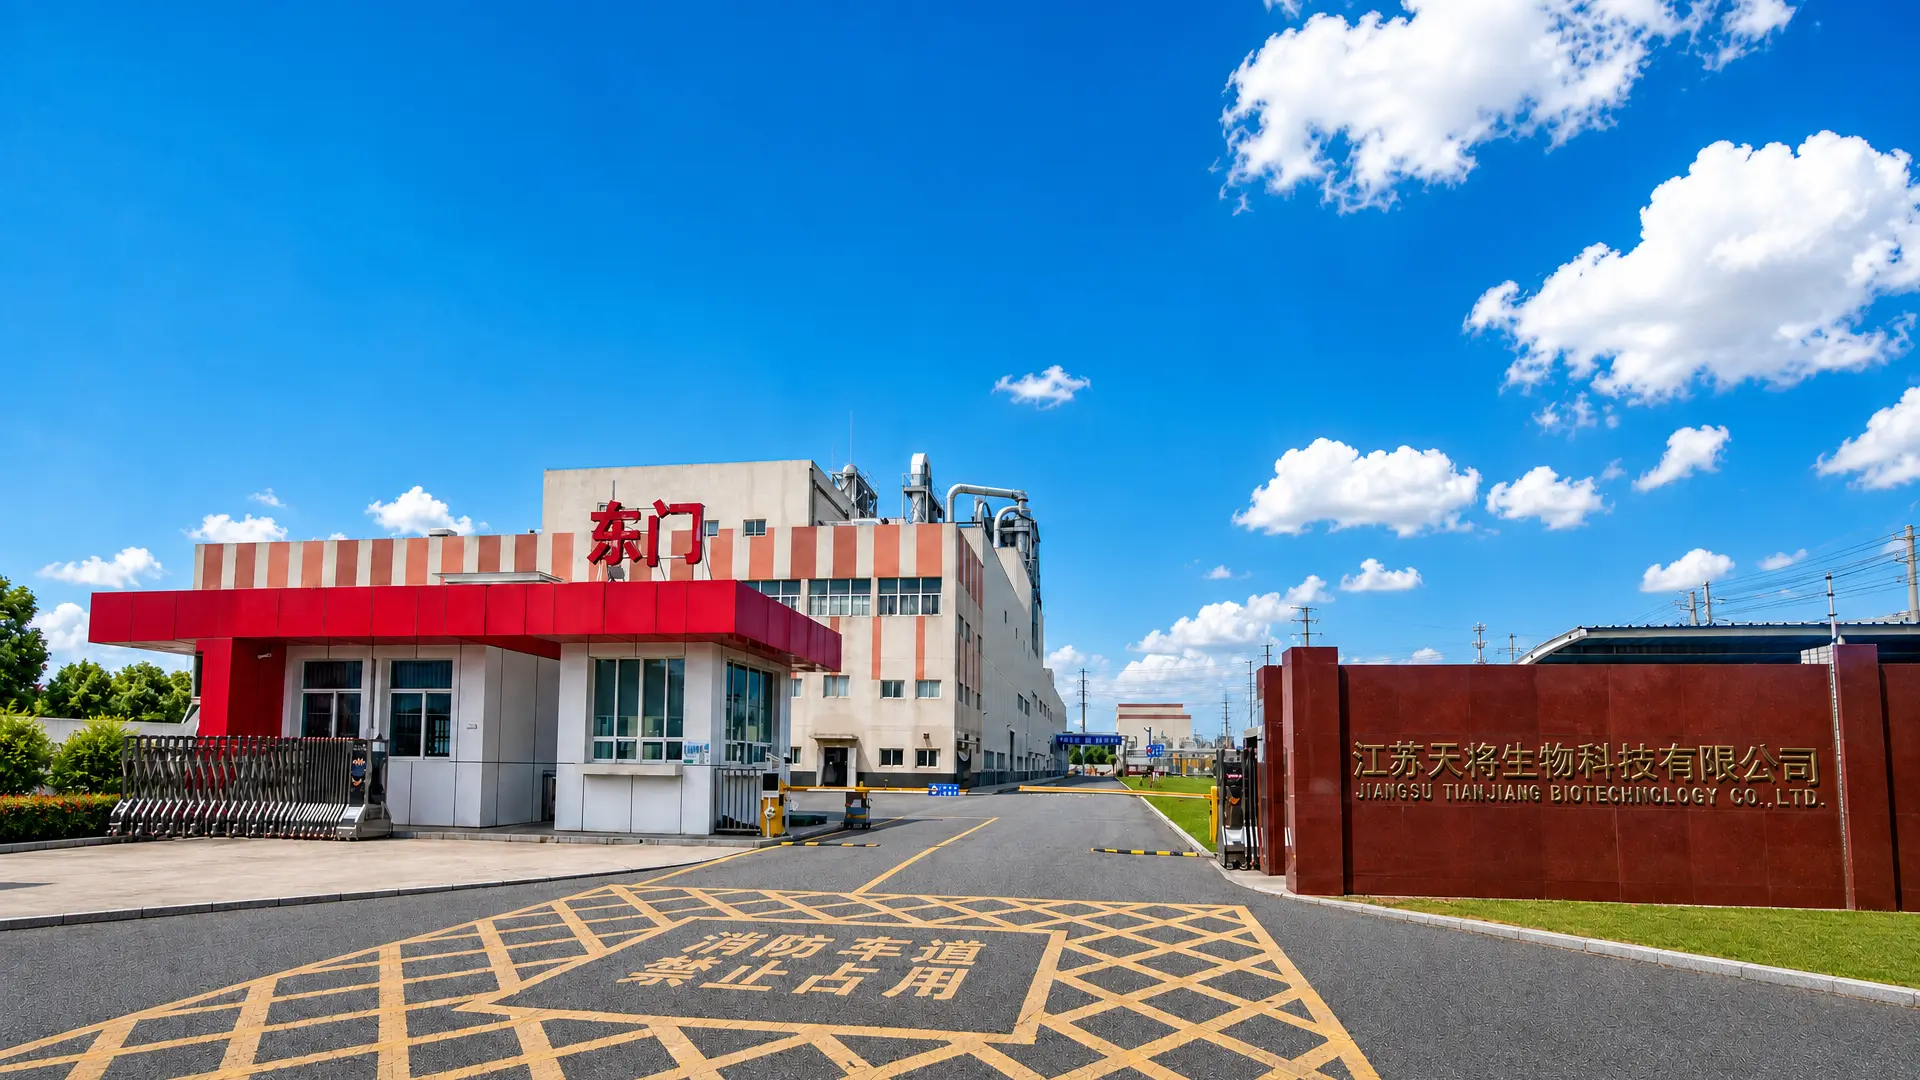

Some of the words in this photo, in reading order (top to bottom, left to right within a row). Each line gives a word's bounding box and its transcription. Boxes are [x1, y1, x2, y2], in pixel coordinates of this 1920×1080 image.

[587, 499, 704, 567] 东门
[1353, 741, 1818, 786] 江苏天将生物科技有限公司
[1355, 783, 1433, 801] JIANGSU
[1443, 784, 1541, 802] TIANJIANG
[681, 931, 987, 966] 消防车道
[616, 956, 969, 1000] 禁止占用
